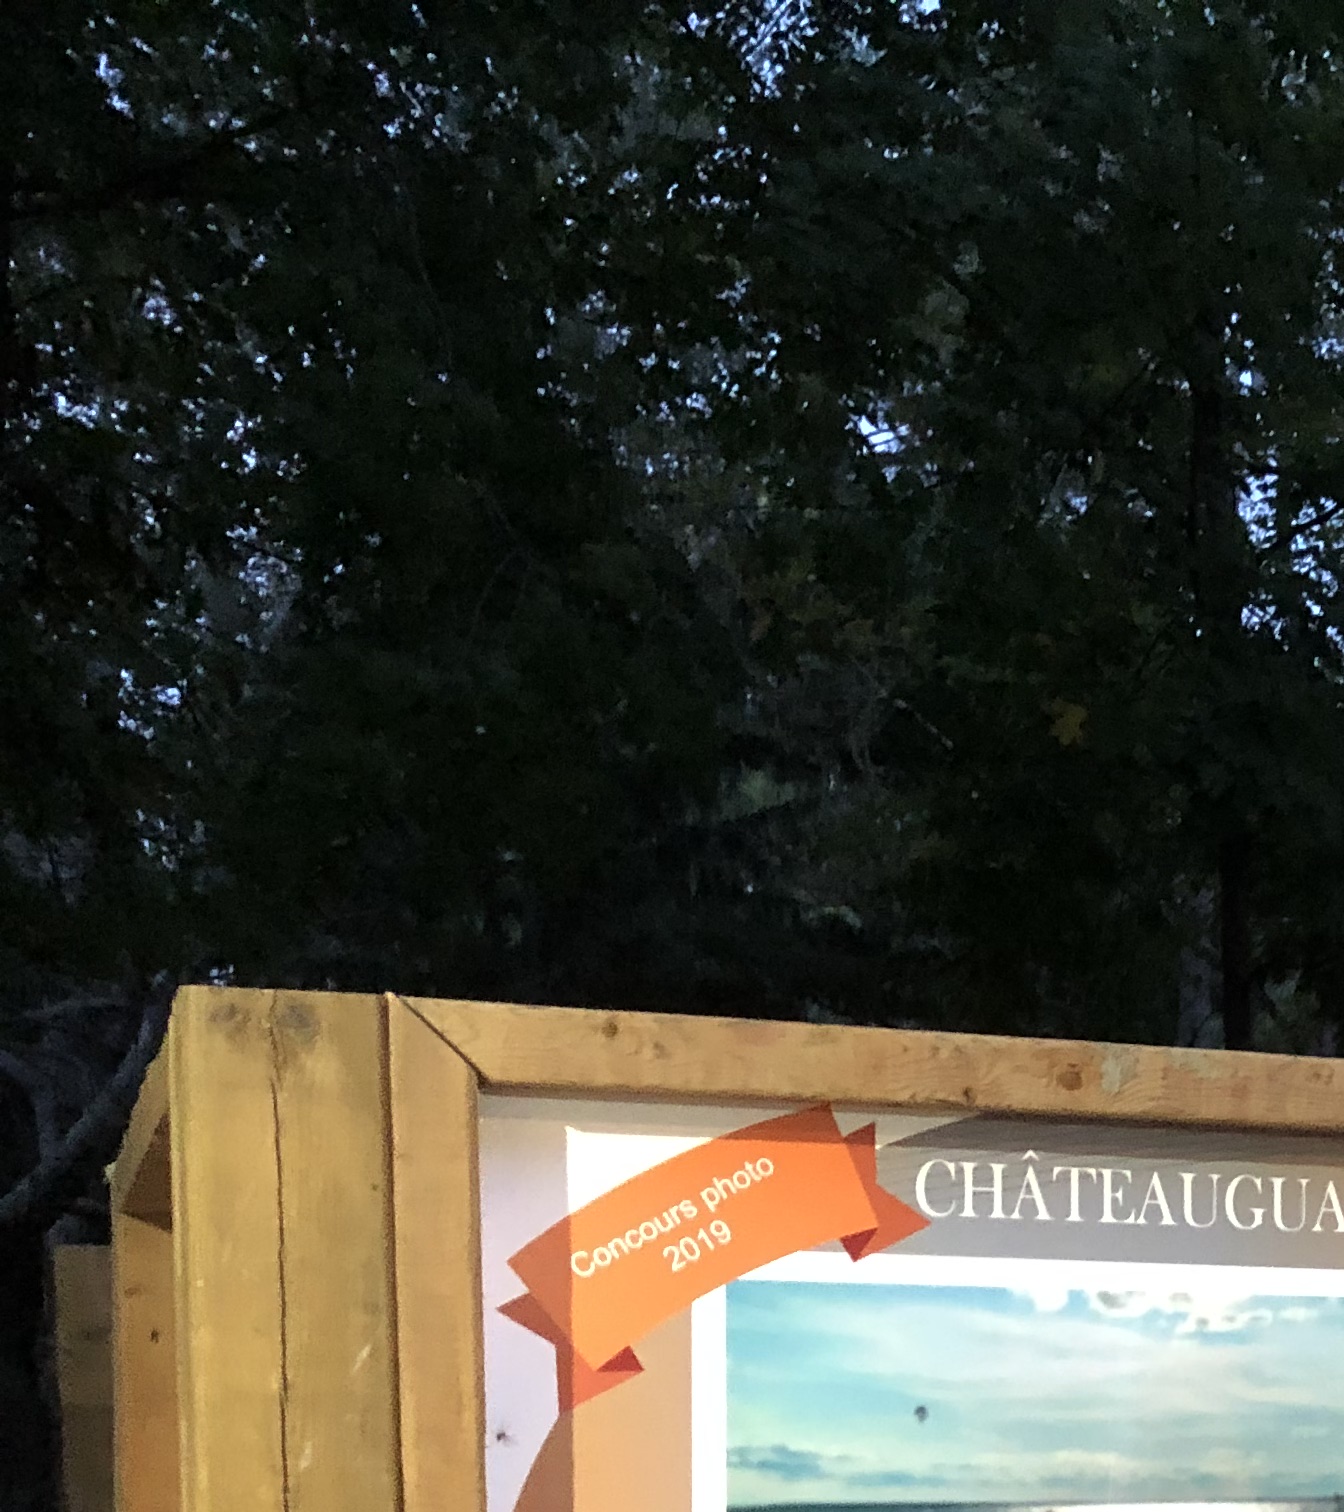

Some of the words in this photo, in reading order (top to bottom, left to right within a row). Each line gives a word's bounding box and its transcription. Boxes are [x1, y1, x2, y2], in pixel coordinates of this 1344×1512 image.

[568, 1194, 699, 1280] Concours
[699, 1155, 776, 1212] photo
[661, 1219, 734, 1275] 2019
